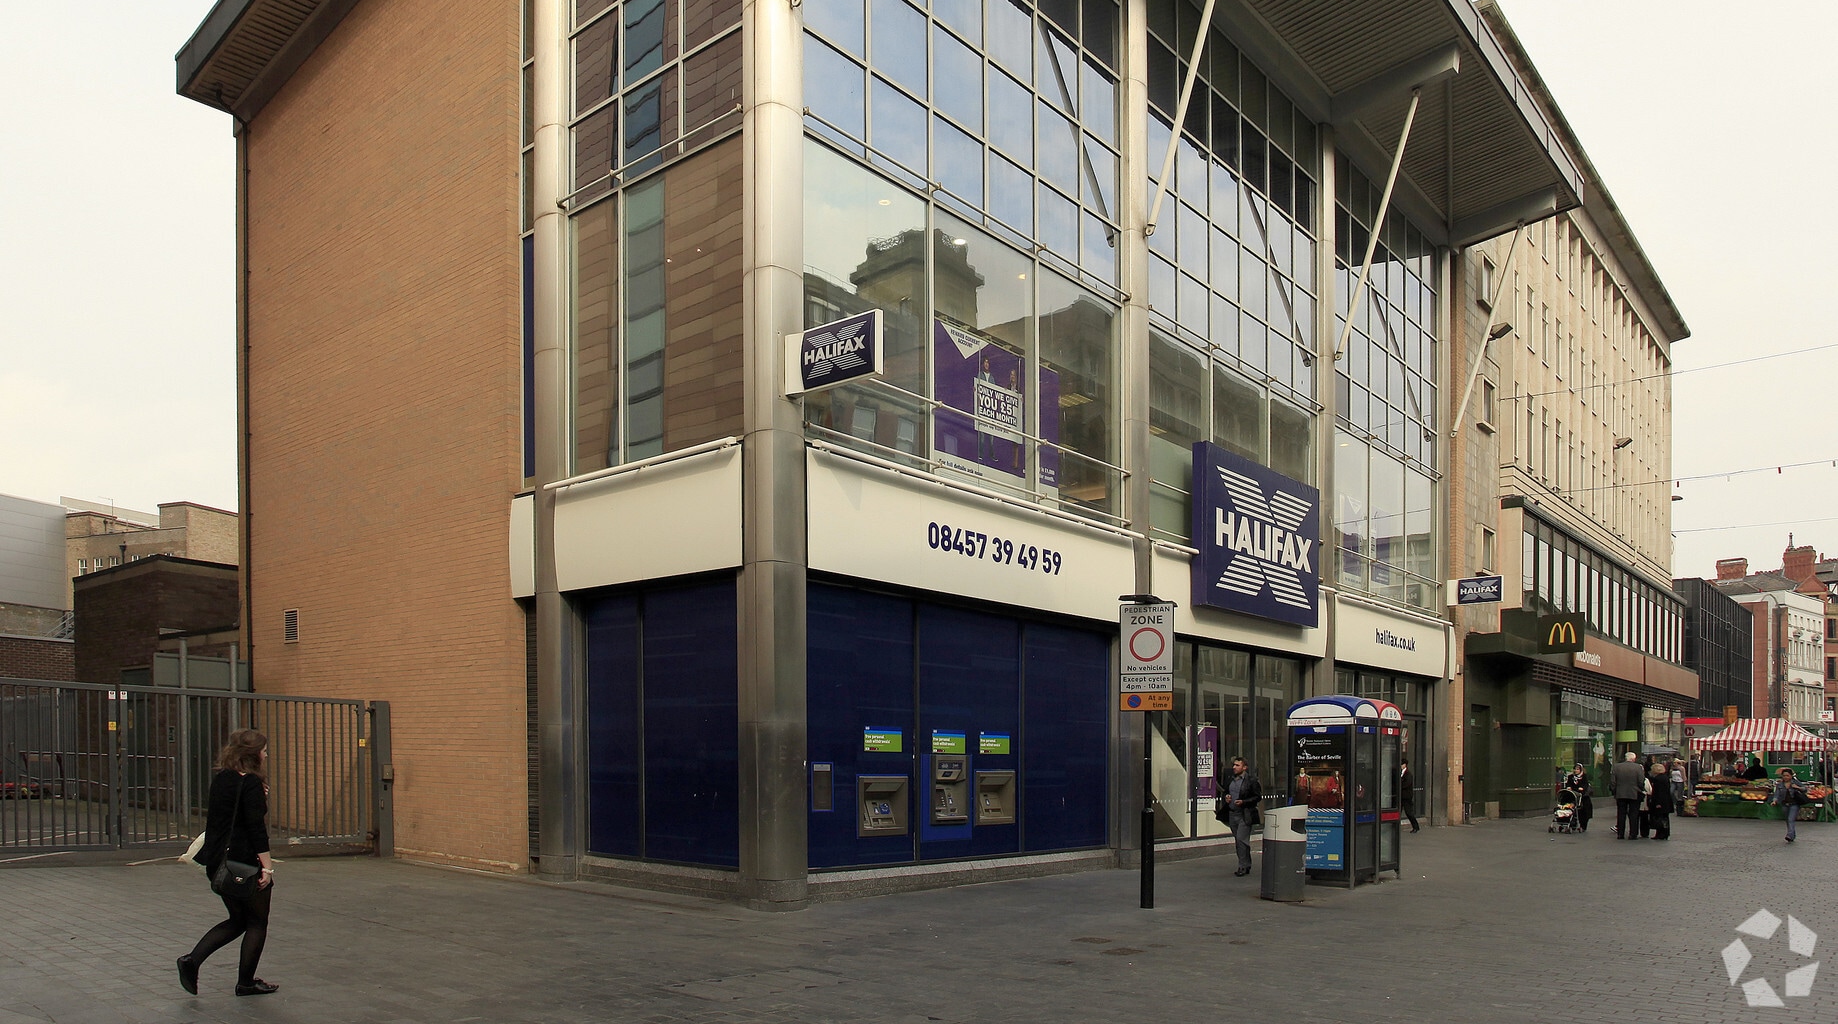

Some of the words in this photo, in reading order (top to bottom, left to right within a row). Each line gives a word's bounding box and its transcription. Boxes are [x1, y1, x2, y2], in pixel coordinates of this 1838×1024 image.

[804, 334, 865, 366] HALIFAX
[979, 385, 995, 397] ONLY
[995, 390, 1005, 402] WE
[1005, 394, 1018, 406] GIVE
[979, 394, 997, 410] YOU
[979, 407, 995, 419] EACH
[996, 412, 1018, 426] MONTH
[928, 521, 987, 560] 08457
[992, 537, 1013, 565] 39
[1017, 543, 1039, 571] 49
[1042, 549, 1062, 576] 59
[1216, 506, 1312, 574] HALIFAX
[1460, 584, 1499, 595] HALIFAX
[1130, 615, 1163, 625] ZONE
[1375, 628, 1416, 652] halifax.co.uk
